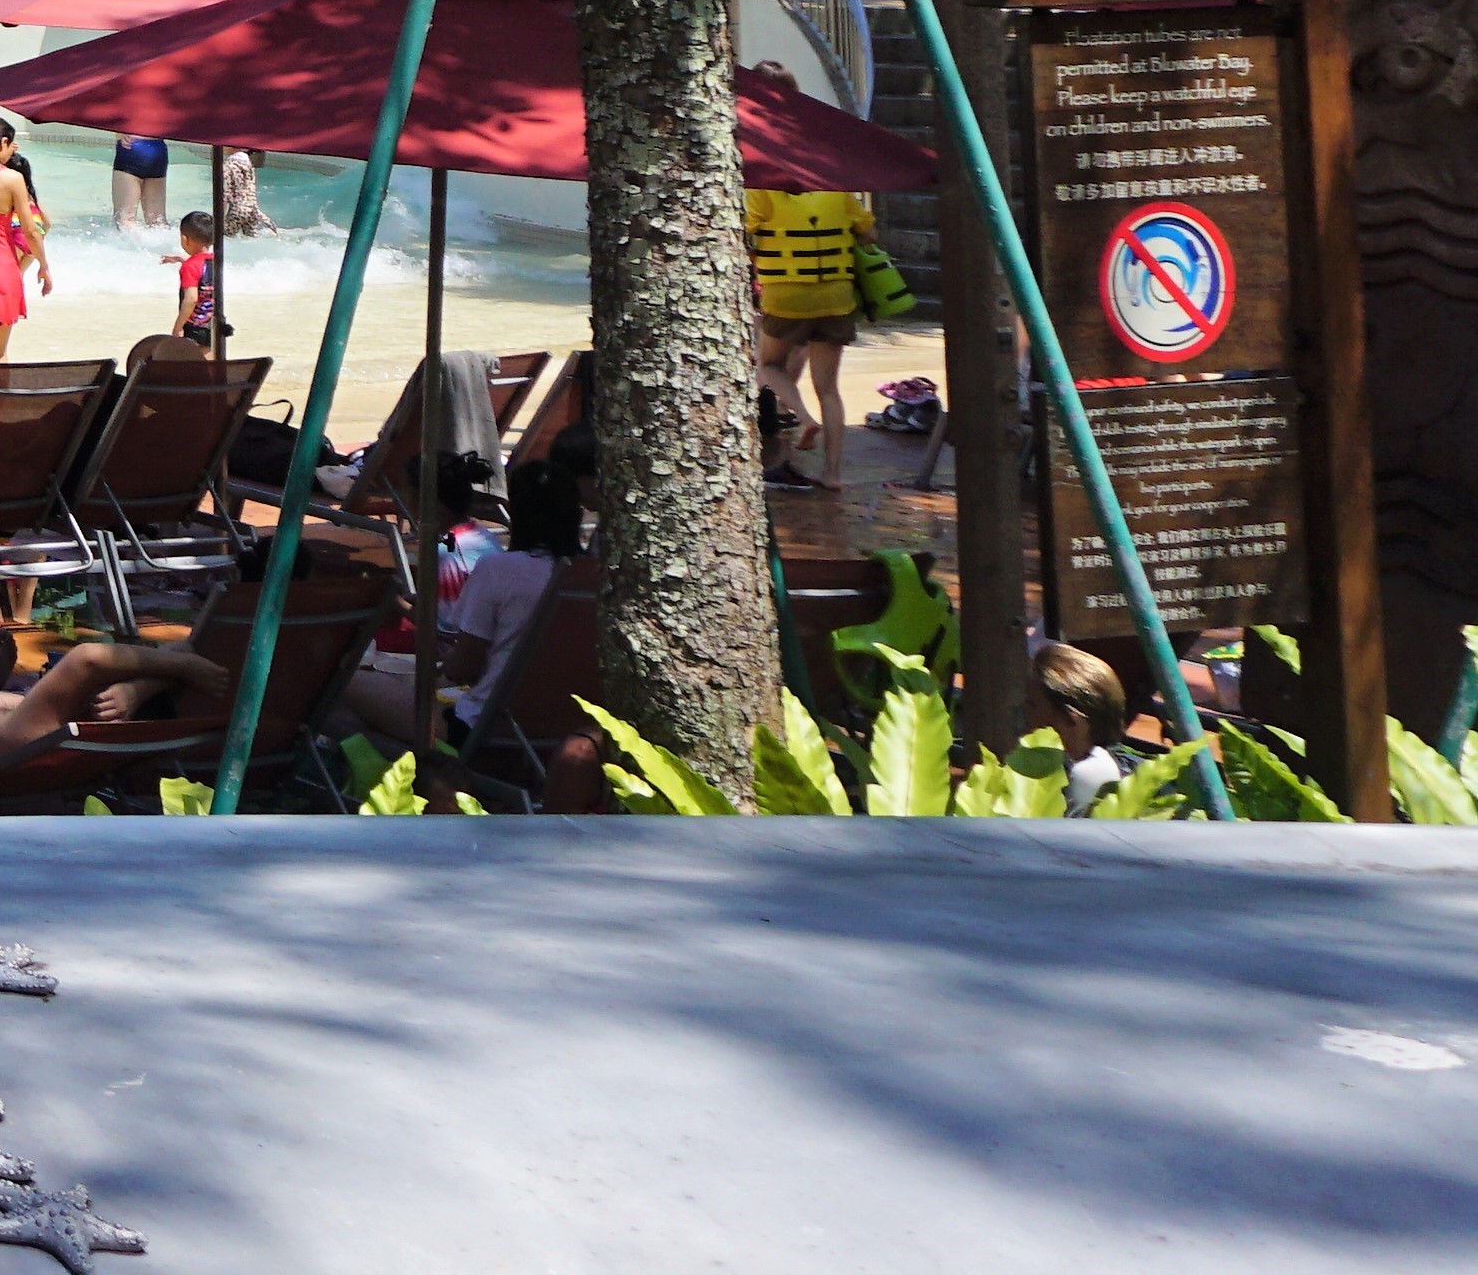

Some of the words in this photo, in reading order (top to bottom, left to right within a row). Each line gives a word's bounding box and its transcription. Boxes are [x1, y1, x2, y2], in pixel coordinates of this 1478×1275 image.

[1055, 53, 1128, 86] permitted
[1129, 59, 1148, 73] at
[1056, 85, 1108, 106] Please
[1108, 83, 1148, 111] keep
[1149, 91, 1161, 102] a
[1162, 78, 1226, 101] watchful
[1227, 86, 1256, 106] eye
[1045, 125, 1067, 137] on
[1068, 113, 1128, 136] children
[1130, 110, 1161, 132] and
